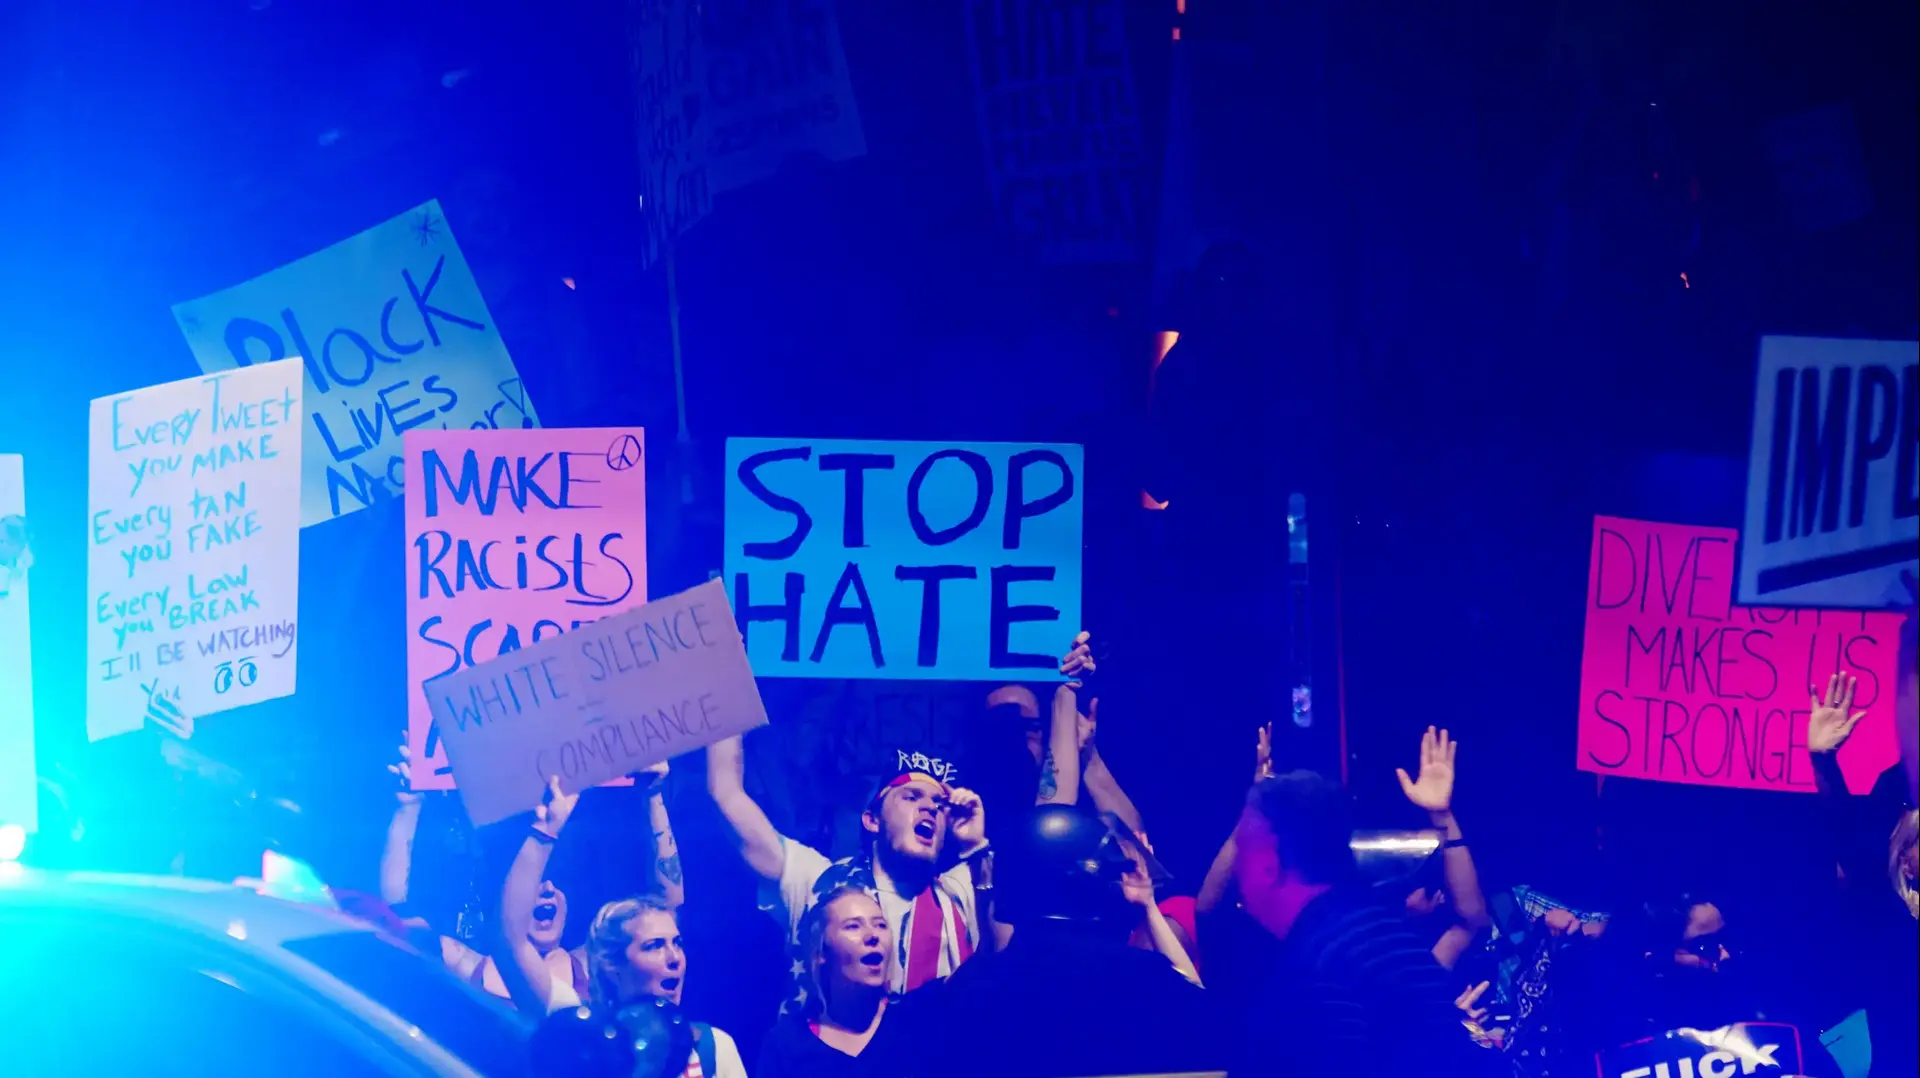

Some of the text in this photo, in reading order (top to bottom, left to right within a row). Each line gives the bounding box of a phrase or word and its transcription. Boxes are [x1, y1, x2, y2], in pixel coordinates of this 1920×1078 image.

[191, 434, 279, 478] MAKE
[422, 449, 607, 517] MAKE
[93, 505, 171, 545] Every
[186, 510, 262, 553] FAKE
[737, 446, 1074, 560] STOP
[169, 590, 260, 630] BREAK
[734, 561, 1061, 669] HATE
[156, 641, 185, 666] BE
[445, 603, 718, 732] WHITE SILENCE
[1625, 624, 1880, 710] MAKES US
[536, 694, 722, 785] COMPLIANCE
[1588, 690, 1814, 786] STRONGE
